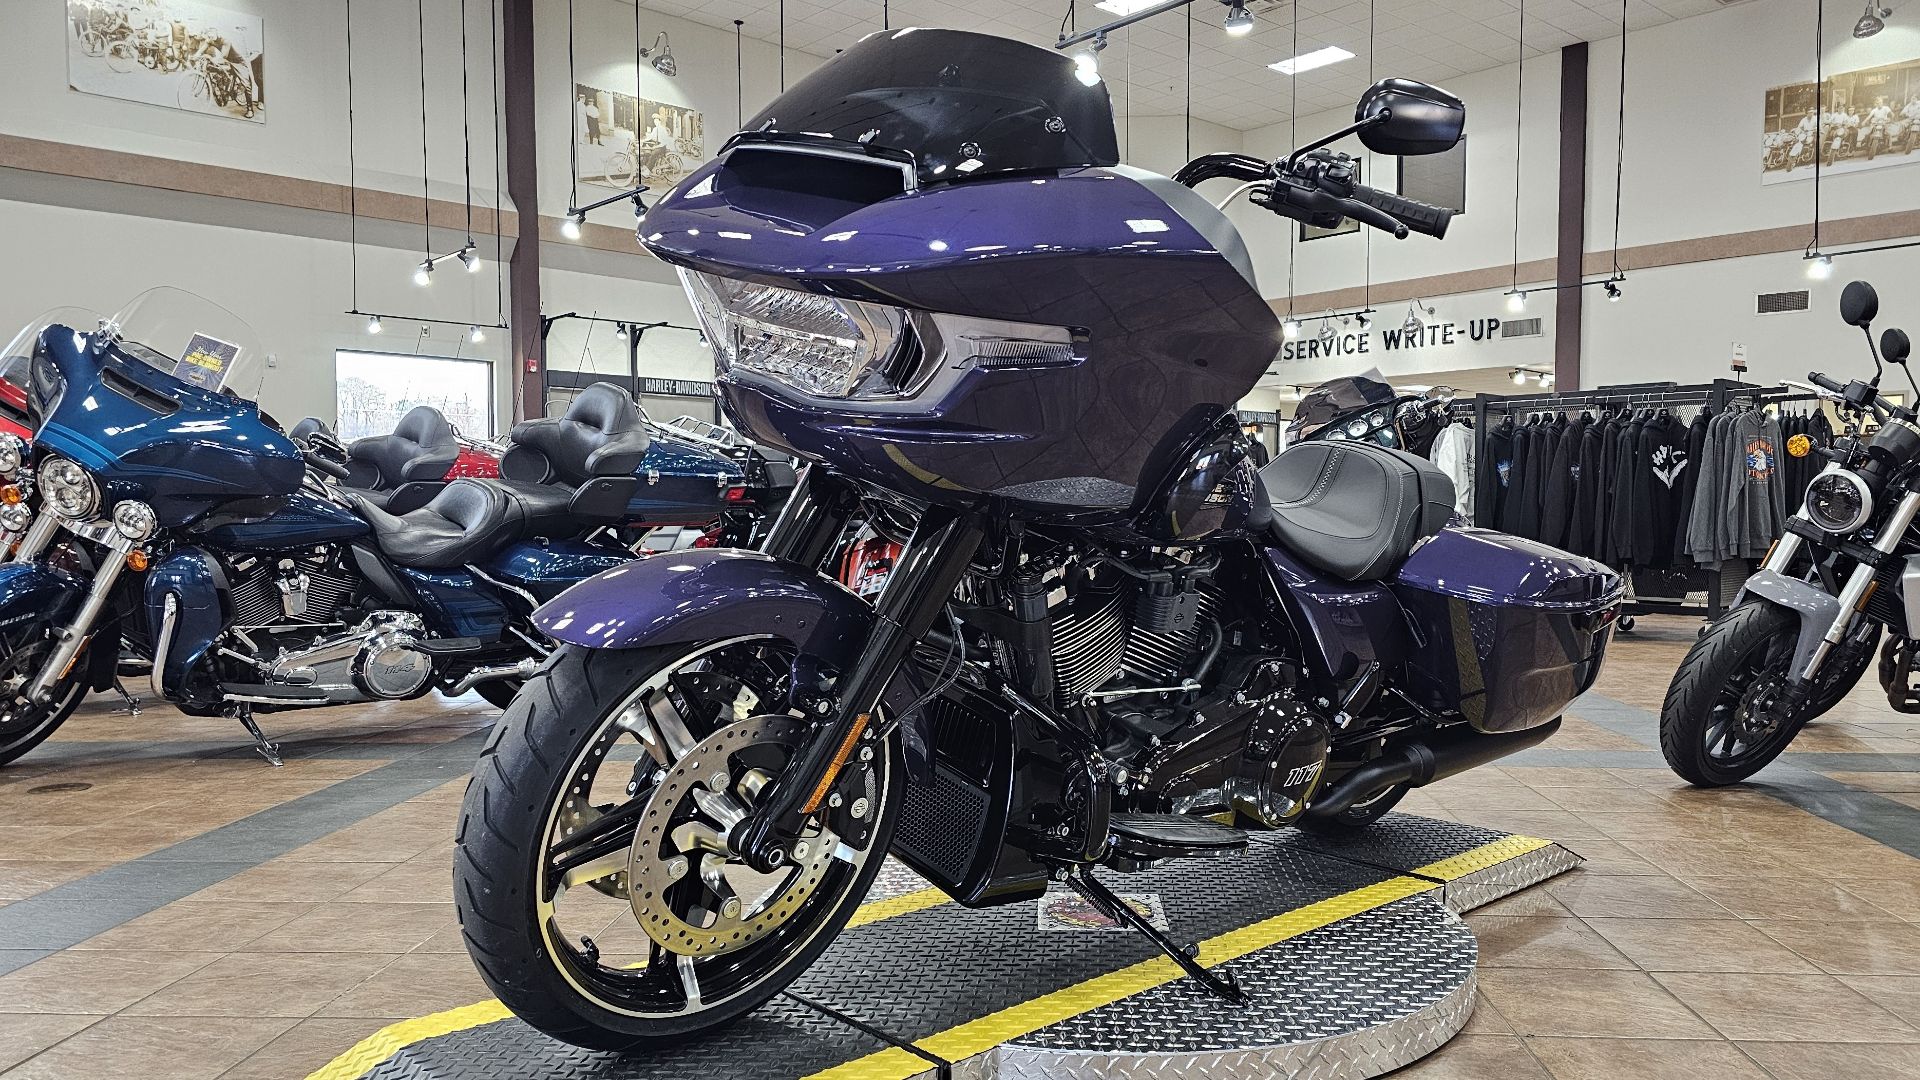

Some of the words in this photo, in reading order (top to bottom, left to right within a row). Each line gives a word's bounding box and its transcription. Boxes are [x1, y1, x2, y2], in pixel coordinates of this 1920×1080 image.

[1283, 333, 1369, 360] SERVICE
[1382, 318, 1500, 351] WRITE-UP
[645, 378, 711, 396] HARLEY-DAVIDSON
[1283, 760, 1323, 788] 117
